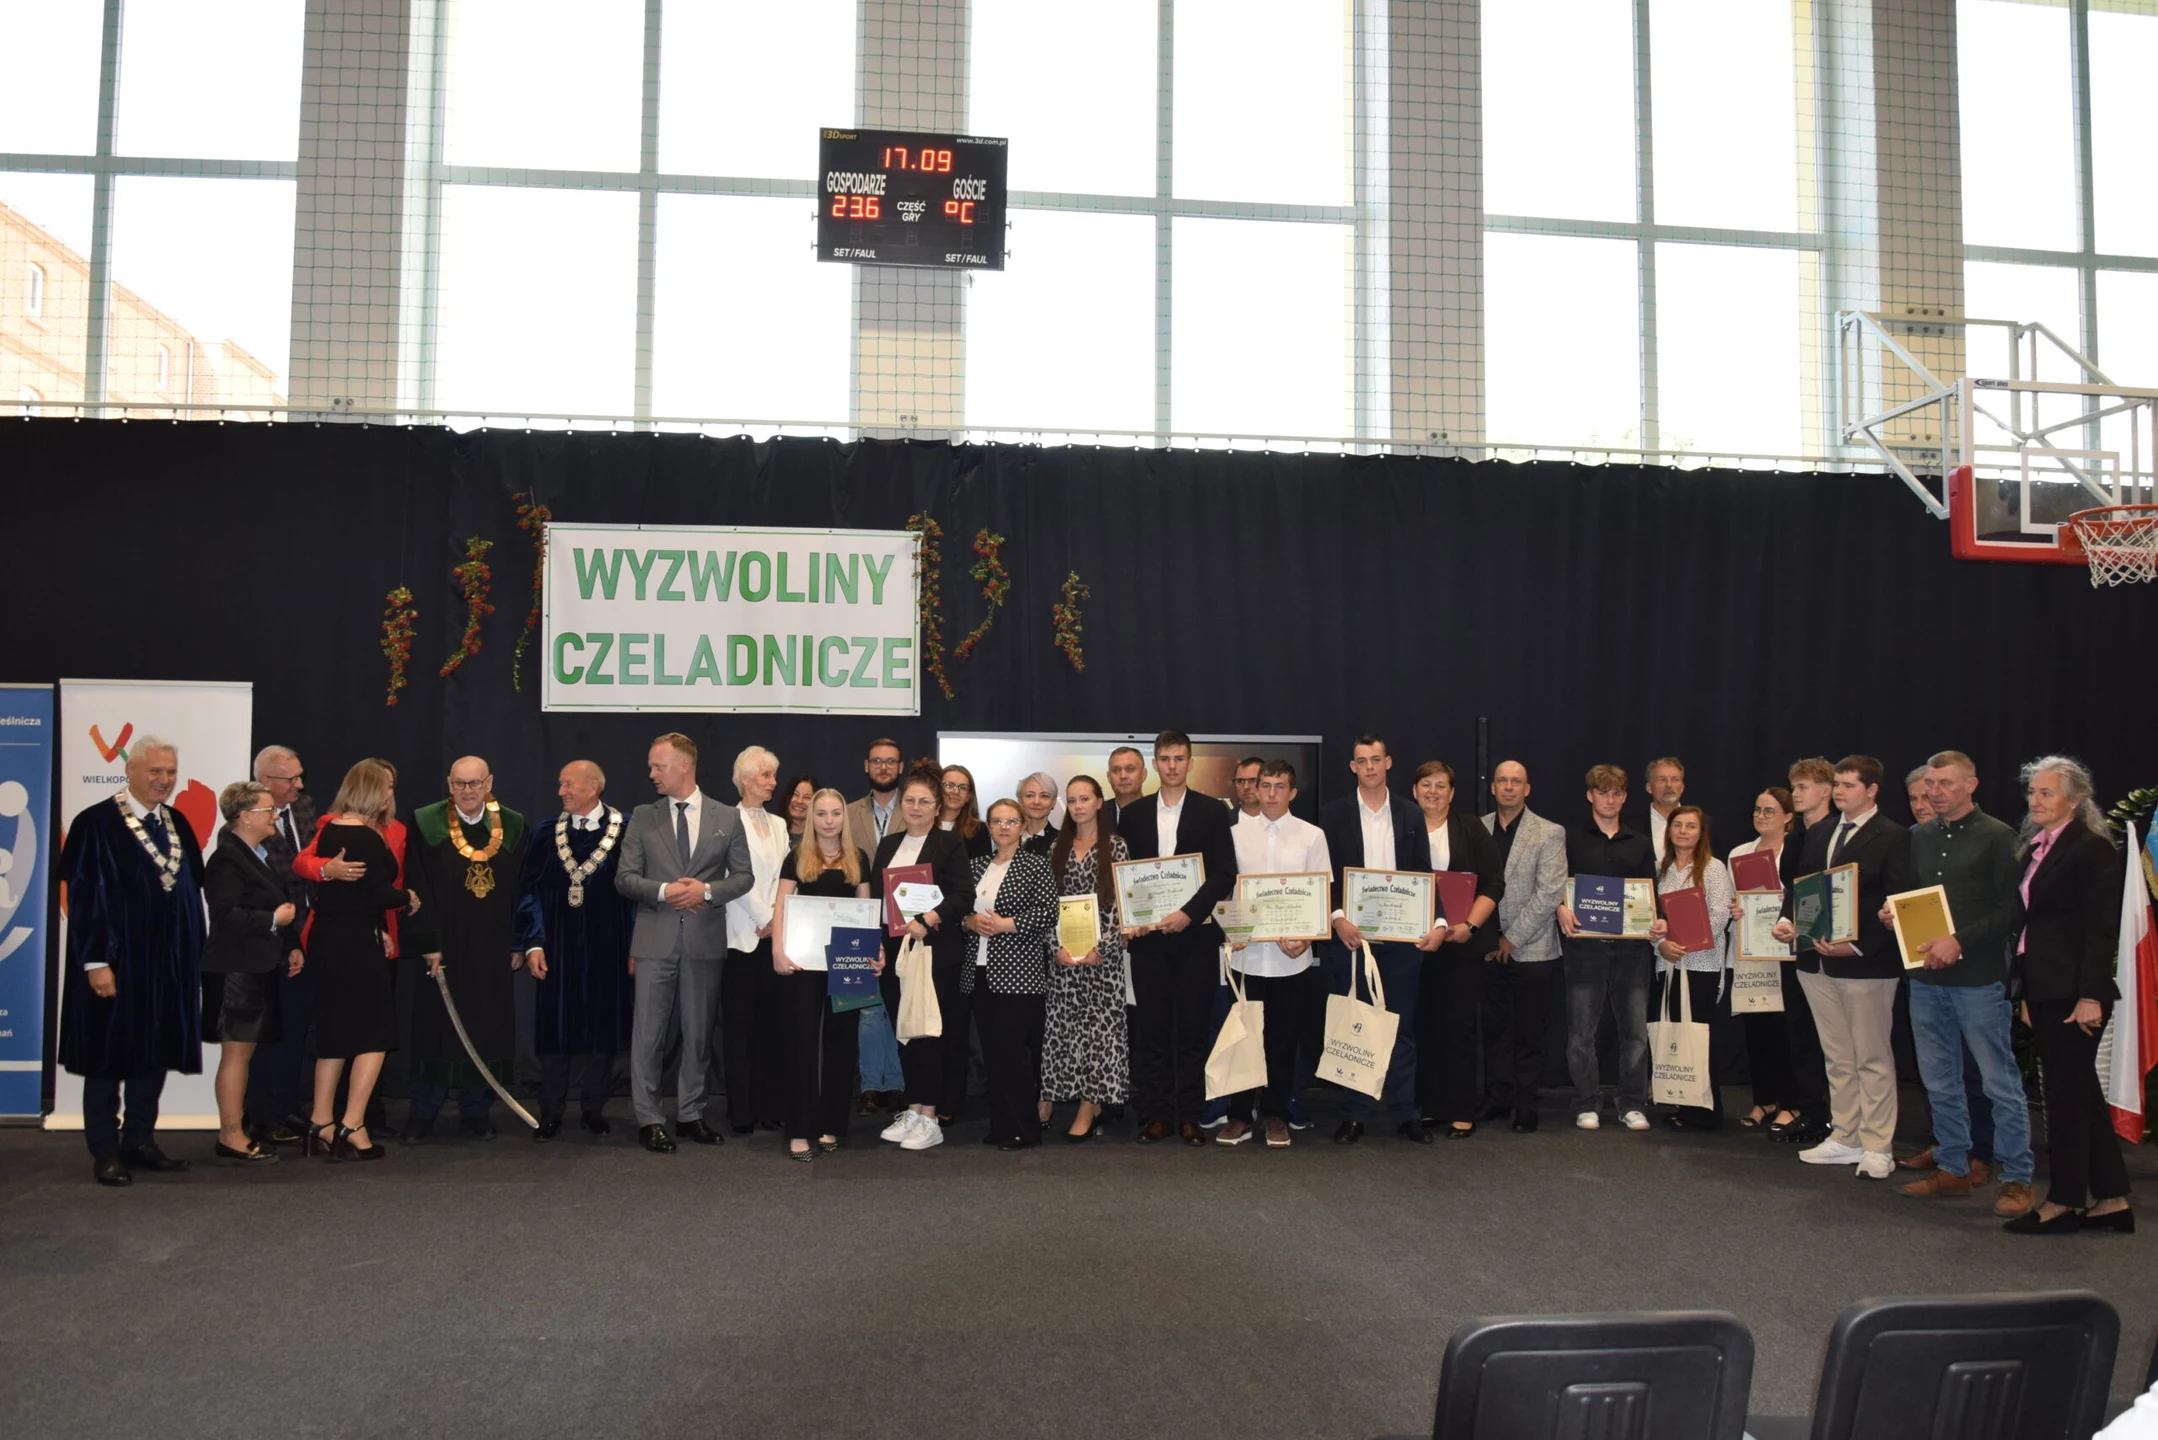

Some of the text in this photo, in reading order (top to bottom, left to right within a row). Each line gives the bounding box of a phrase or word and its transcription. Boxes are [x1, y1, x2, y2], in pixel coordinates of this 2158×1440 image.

[956, 138, 1007, 146] www.3d.com.pl
[885, 148, 951, 171] 17.09
[827, 171, 887, 195] GOSPODARZE
[953, 175, 987, 200] GOŚCIE
[897, 201, 926, 213] CZĘŚĆ
[902, 212, 921, 222] GRY
[572, 547, 895, 605] WYZWOLINY
[552, 632, 912, 689] CZELADNICZE
[0, 716, 41, 726] eślnicza
[1578, 903, 1621, 913] CZELADNICZE
[1581, 898, 1619, 906] WYZWOLINY
[1735, 971, 1778, 980] WYZWOLINY
[1734, 980, 1780, 989] CZELADNICZE
[1330, 1038, 1376, 1059] WYZWOLINY
[1325, 1046, 1376, 1069] CZELADNICZE
[1655, 1063, 1695, 1073] WYZWOLINY
[1653, 1071, 1697, 1083] CZELADNICZE
